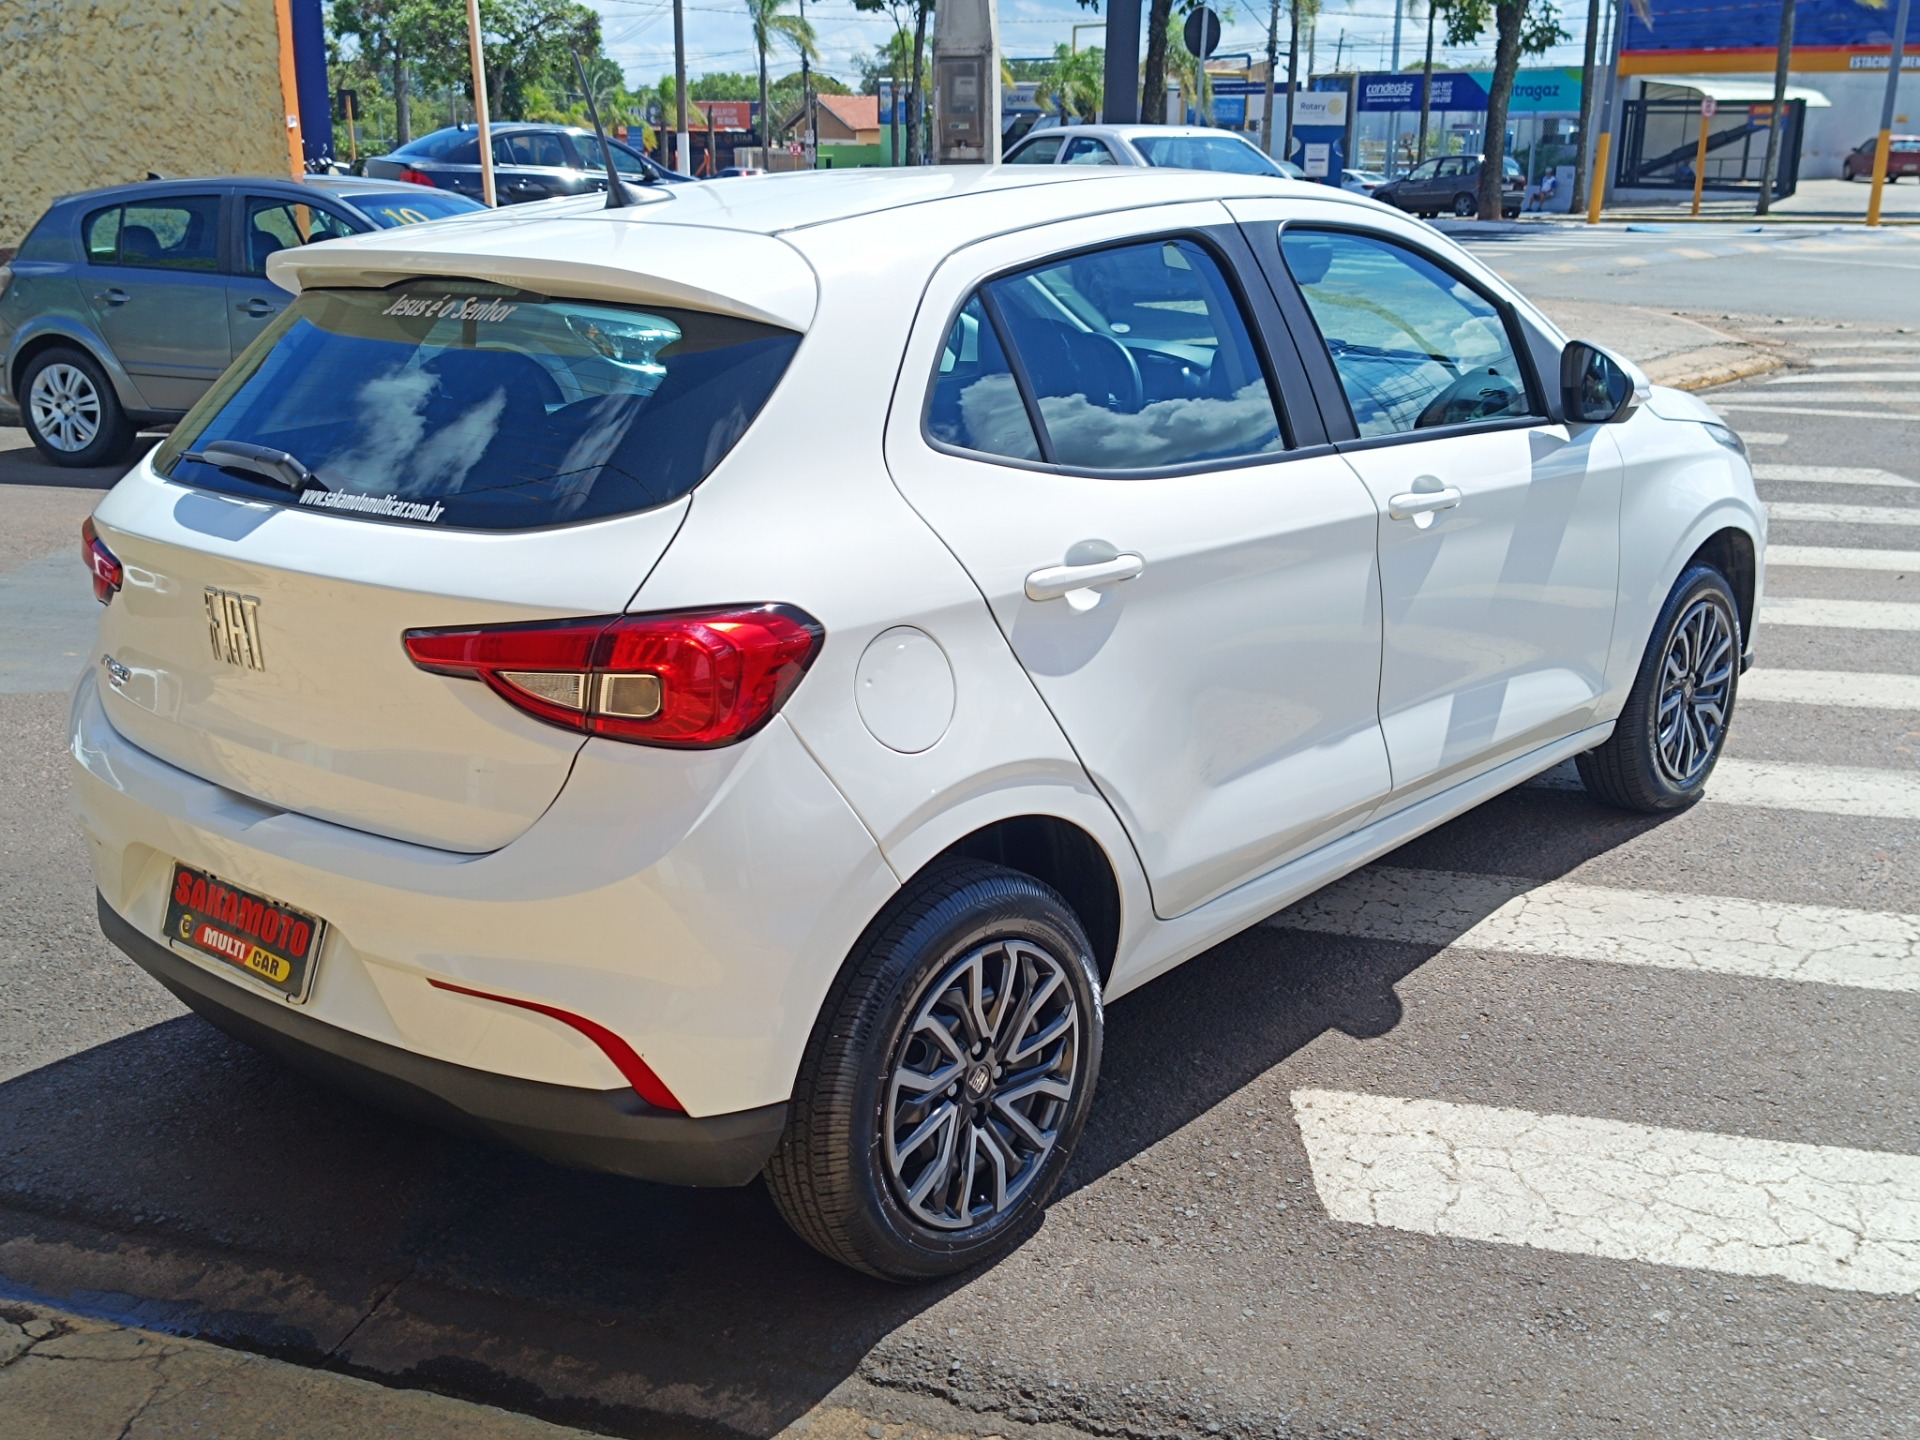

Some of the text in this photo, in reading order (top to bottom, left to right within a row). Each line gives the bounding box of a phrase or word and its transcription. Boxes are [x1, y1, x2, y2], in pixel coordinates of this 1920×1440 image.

[1300, 102, 1326, 112] Rotary
[382, 294, 519, 322] Jesus é o Senhor
[299, 488, 445, 523] www.sakamotomulticar.com.br
[204, 585, 265, 672] FIAT
[175, 871, 310, 958] SAKAMOTO
[203, 926, 280, 977] MULTI CAR
